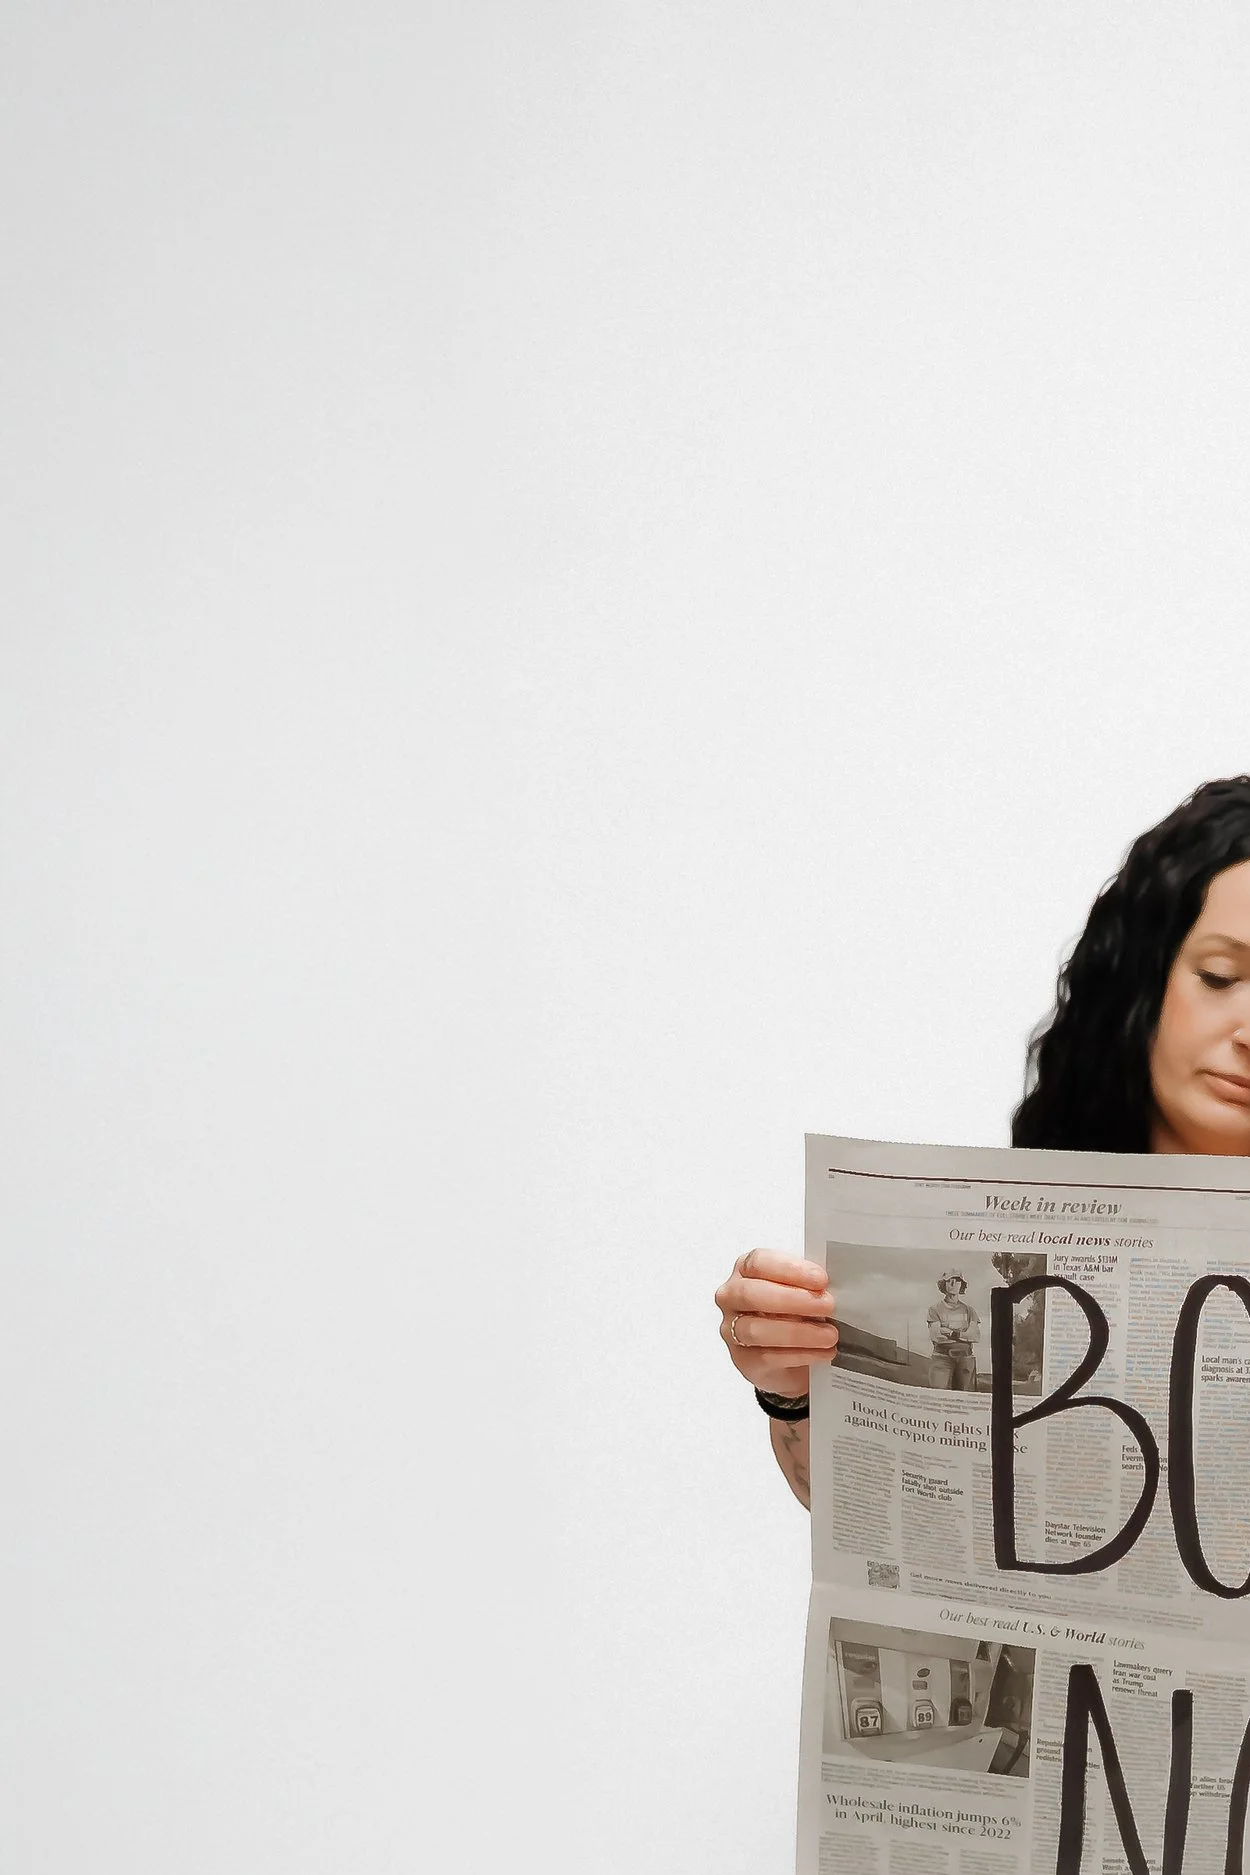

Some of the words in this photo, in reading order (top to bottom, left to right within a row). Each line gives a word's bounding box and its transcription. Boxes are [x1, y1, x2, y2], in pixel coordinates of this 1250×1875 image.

[984, 1195, 1031, 1211] Week
[1037, 1197, 1056, 1212] in
[1061, 1200, 1123, 1214] review
[949, 1228, 975, 1241] Our
[1038, 1232, 1073, 1246] local
[1076, 1236, 1112, 1247] news
[1114, 1236, 1154, 1249] stories
[1053, 1254, 1068, 1262] Jury
[1071, 1255, 1095, 1263] awards
[1098, 1255, 1118, 1264] $131M
[1063, 1263, 1081, 1272] Texas
[1083, 1264, 1100, 1272] A&M
[1102, 1264, 1114, 1272] bar
[1201, 1354, 1220, 1363] Local
[1201, 1363, 1234, 1374] diagnosis
[1235, 1366, 1243, 1374] at
[1200, 1373, 1223, 1383] sparks
[852, 1400, 888, 1420] Hood
[891, 1412, 939, 1432] County
[944, 1420, 982, 1436] fights
[844, 1413, 889, 1433] against
[892, 1427, 936, 1443] crypto
[939, 1436, 987, 1452] mining
[1121, 1444, 1138, 1453] Feds
[1121, 1462, 1144, 1471] search
[902, 1469, 926, 1483] Security
[928, 1478, 948, 1486] guard
[902, 1476, 921, 1488] fatally
[923, 1483, 937, 1491] shot
[938, 1487, 964, 1495] outside
[902, 1484, 915, 1493] Fort
[917, 1487, 936, 1499] Worth
[938, 1493, 952, 1501] club
[1044, 1520, 1070, 1530] Daystar
[1072, 1523, 1106, 1534] Television
[1044, 1527, 1073, 1538] Network
[1075, 1532, 1103, 1541] founder
[1044, 1535, 1058, 1543] dies
[910, 1571, 922, 1579] Get
[964, 1581, 998, 1592] delivered
[999, 1586, 1026, 1597] directly
[939, 1607, 964, 1623] Our
[1022, 1621, 1046, 1636] U.S.
[1049, 1625, 1062, 1637] &
[1064, 1627, 1106, 1645] World
[1107, 1634, 1146, 1651] stories
[1112, 1668, 1126, 1677] Iran
[1113, 1659, 1151, 1673] Lawmakers
[1152, 1667, 1174, 1677] query
[1121, 1677, 1144, 1688] Trump
[1111, 1686, 1136, 1695] renews
[1137, 1688, 1158, 1698] threat
[859, 1714, 879, 1728] 87
[917, 1711, 932, 1723] 89
[825, 1792, 896, 1813] Wholesale
[898, 1802, 955, 1820] inflation
[955, 1810, 998, 1827] jumps
[1000, 1815, 1022, 1828] 6%
[834, 1808, 848, 1820] in
[889, 1813, 938, 1831] highest
[942, 1822, 976, 1837] since
[978, 1826, 1012, 1840] 2022
